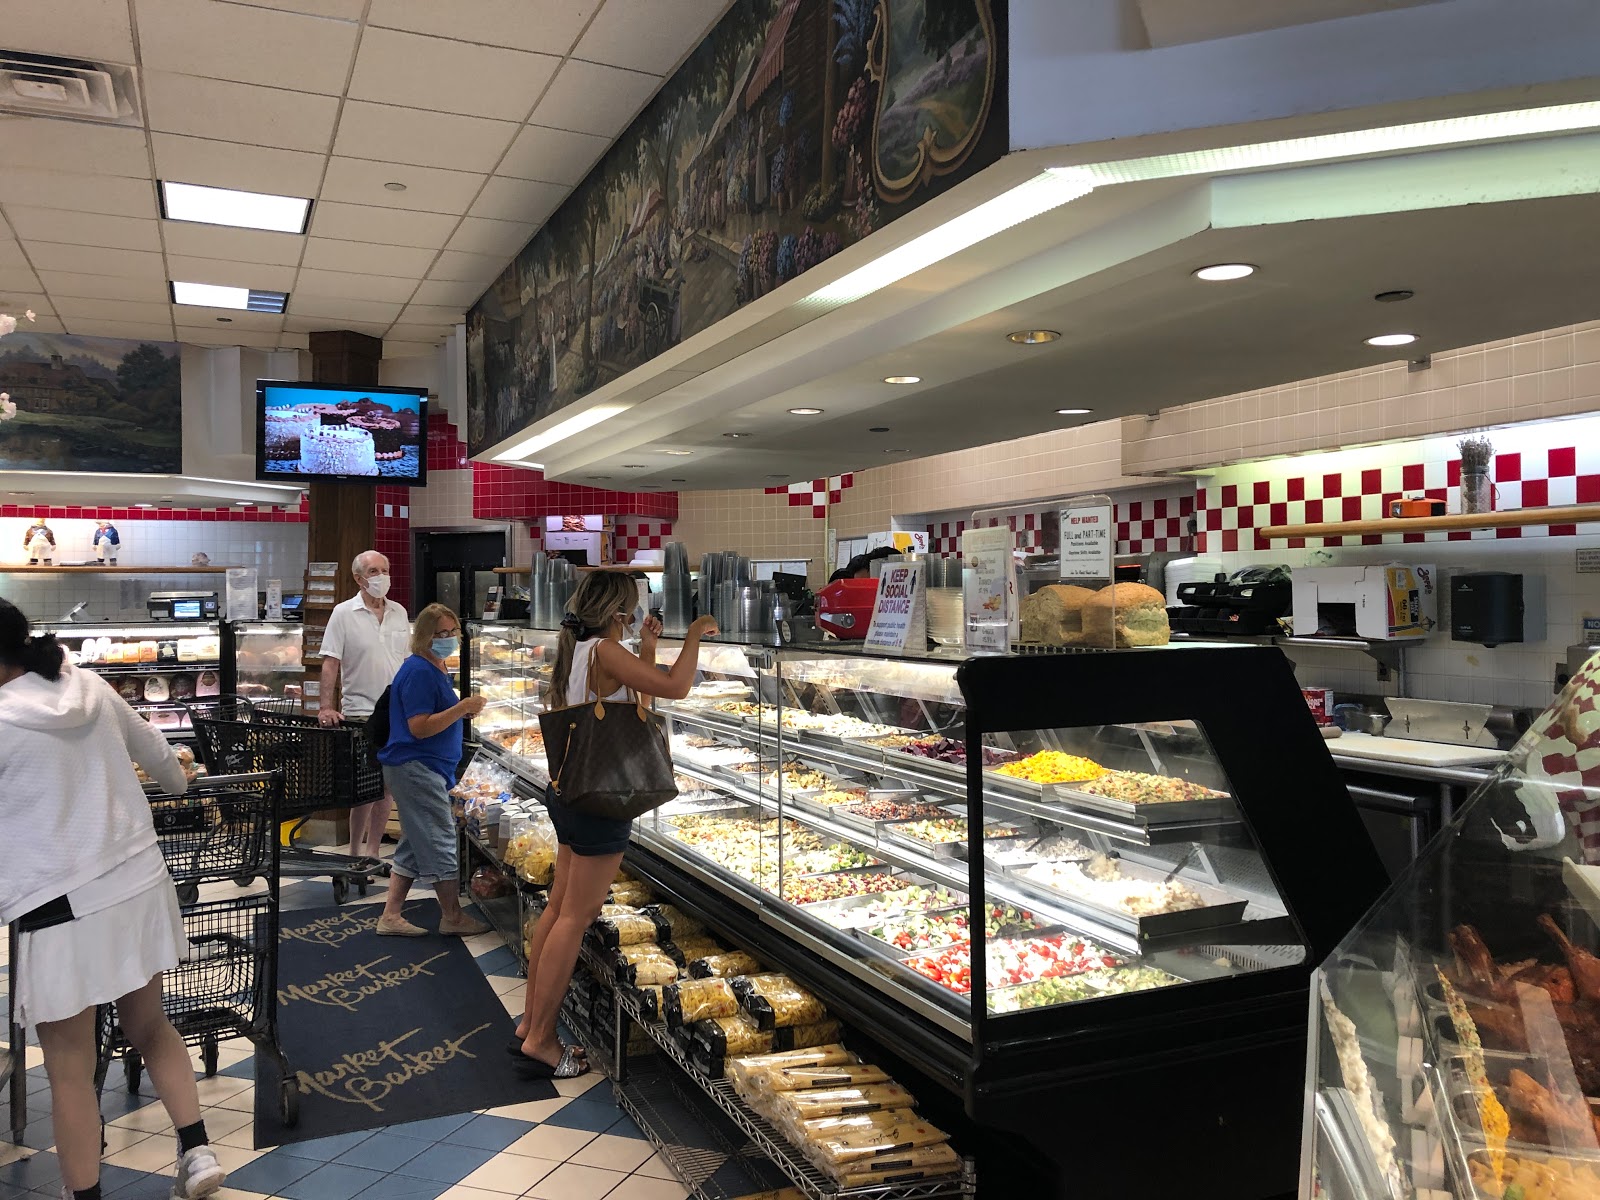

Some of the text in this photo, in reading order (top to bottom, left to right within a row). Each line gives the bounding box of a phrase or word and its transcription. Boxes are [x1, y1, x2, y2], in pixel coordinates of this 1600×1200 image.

[1064, 531, 1073, 539] FULL
[1083, 529, 1106, 538] PART-TIME
[891, 569, 909, 583] KEEP
[885, 585, 908, 598] SOCIAL
[878, 600, 910, 614] DISTANCE
[278, 906, 373, 944] Market
[277, 955, 392, 1005] Market
[326, 951, 450, 1012] Basket
[344, 1022, 492, 1112] Basket
